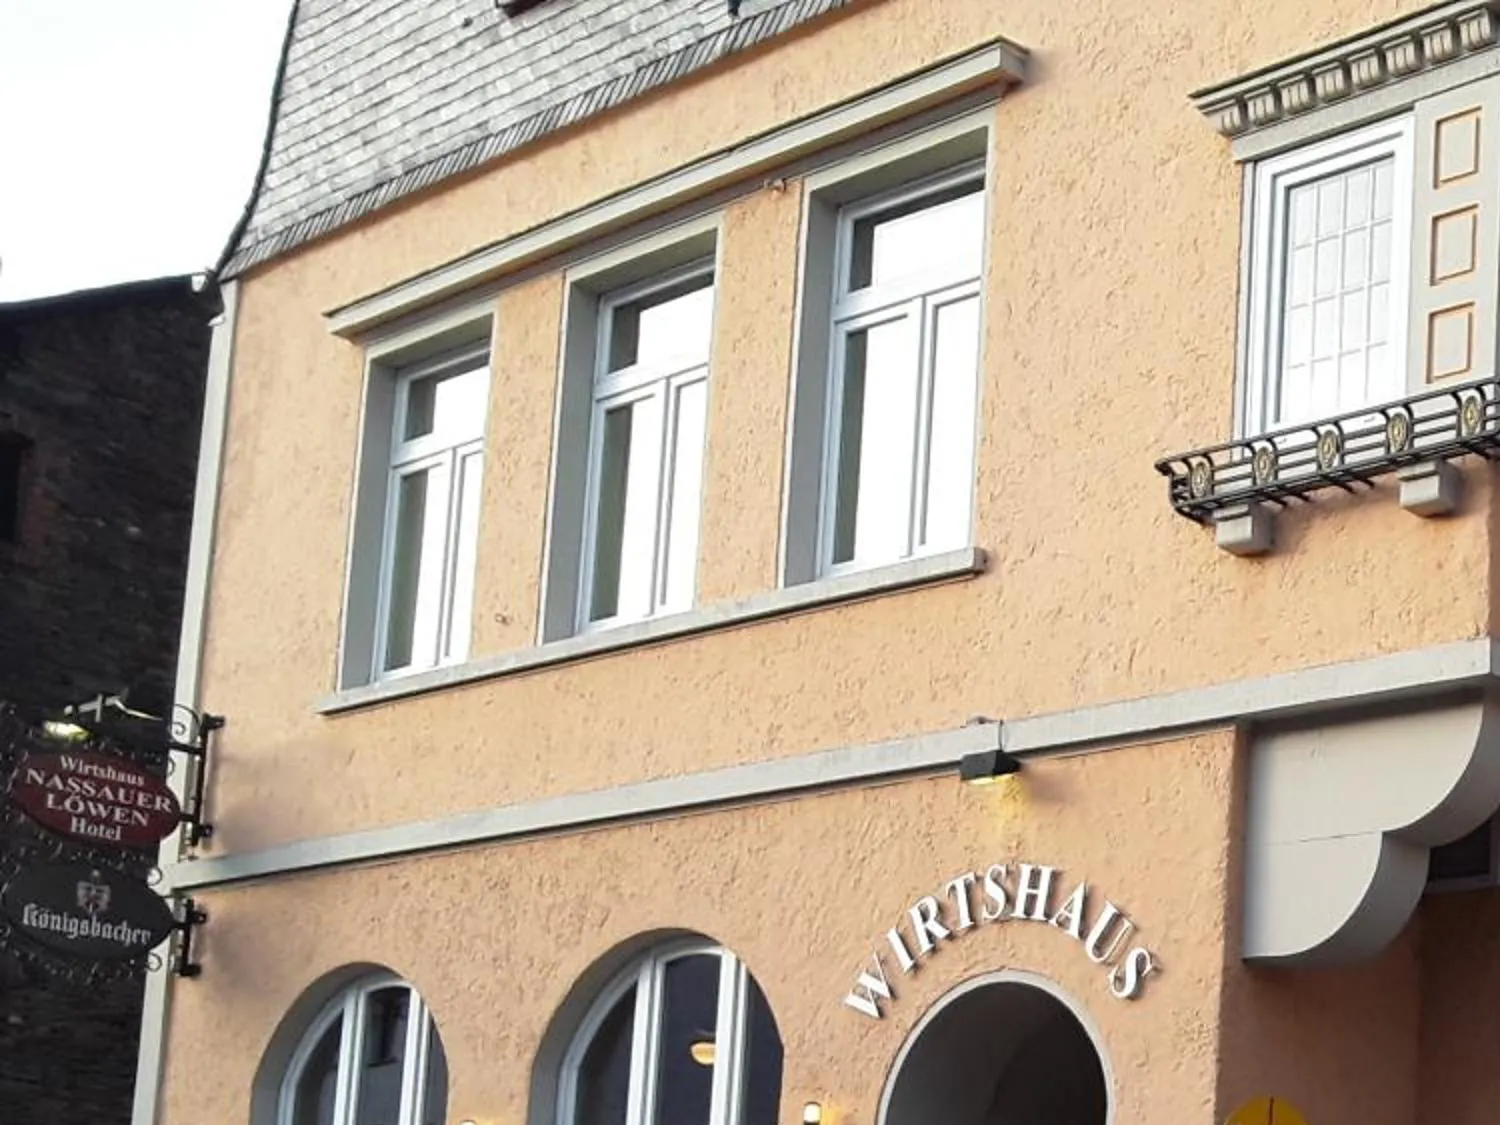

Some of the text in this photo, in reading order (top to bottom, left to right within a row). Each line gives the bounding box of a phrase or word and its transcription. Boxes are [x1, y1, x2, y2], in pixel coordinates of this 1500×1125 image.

[25, 768, 173, 813] NASSAUER
[59, 755, 145, 786] Wirtshaus
[47, 790, 149, 827] LÖWEN
[71, 815, 122, 841] Hotel
[22, 902, 151, 946] Königsbacher
[844, 863, 1155, 1018] WIRTSHAUS
